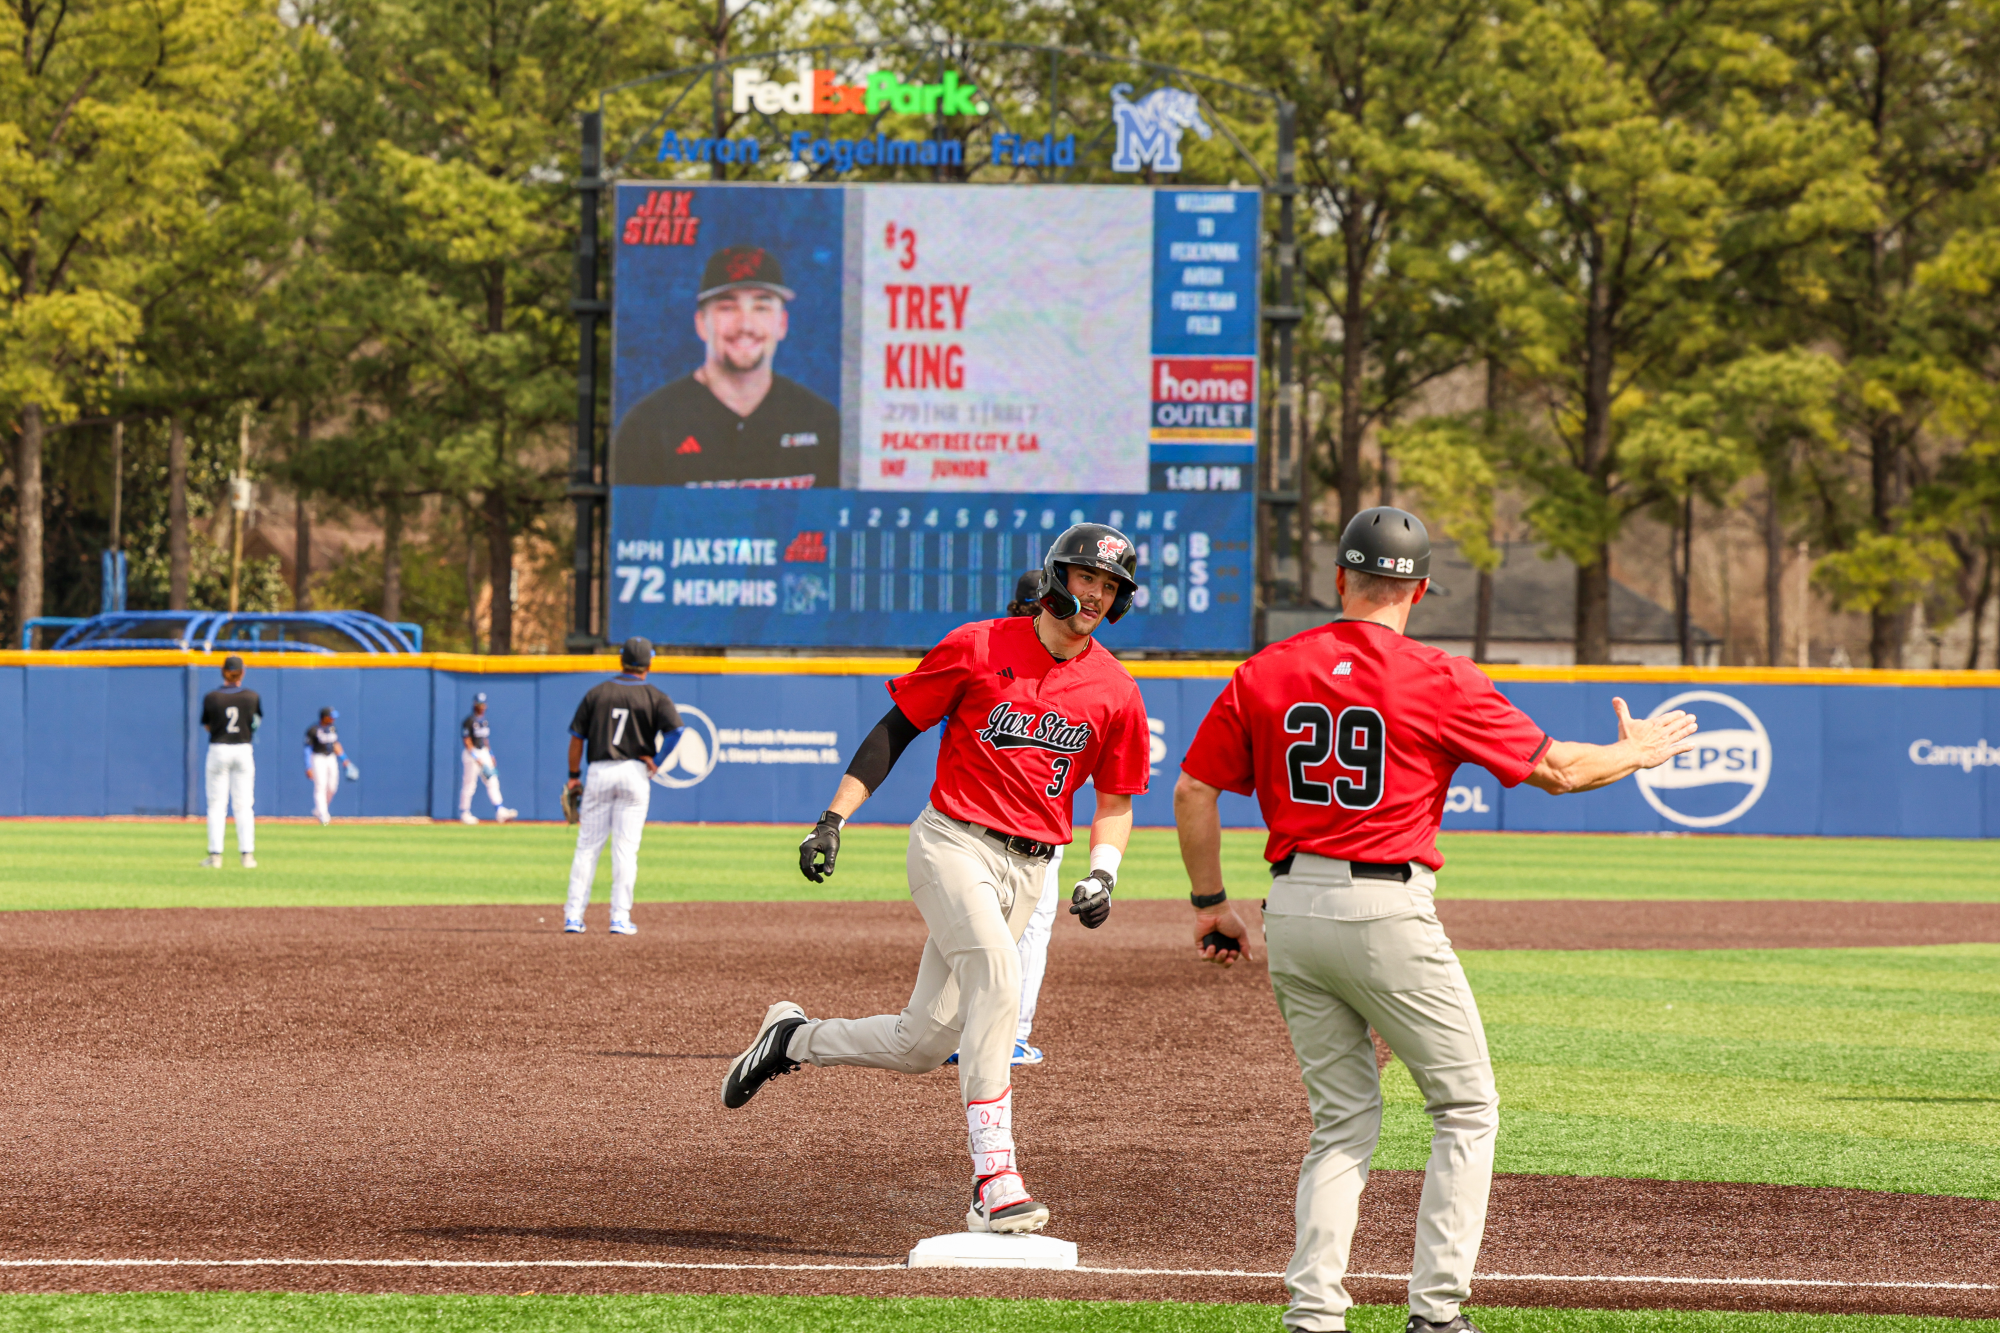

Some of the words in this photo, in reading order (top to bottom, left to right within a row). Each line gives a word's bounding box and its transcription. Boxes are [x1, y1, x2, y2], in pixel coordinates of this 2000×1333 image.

[658, 130, 759, 163] Avron
[790, 131, 961, 173] Fogelman
[991, 133, 1075, 167] Field
[636, 190, 695, 217] JAX
[623, 217, 699, 245] STATE
[884, 284, 970, 330] TREY
[884, 344, 965, 389] KING
[1160, 363, 1248, 402] home
[1157, 404, 1248, 427] OUTLET
[1209, 467, 1241, 490] PM
[839, 508, 849, 527] 1
[868, 508, 883, 528] 2
[897, 508, 911, 528] 3
[924, 508, 938, 528] 4
[956, 508, 969, 528] 5
[984, 509, 999, 529] 6
[1013, 509, 1028, 529] 7
[616, 540, 664, 561] MPH
[671, 538, 711, 568] JAX
[712, 538, 777, 565] STATE
[1162, 543, 1179, 566] 0
[1189, 532, 1210, 558] B
[1189, 560, 1209, 586] S
[1396, 558, 1415, 574] 29
[615, 566, 666, 603] 72
[672, 579, 777, 606] MEMPHIS
[1162, 584, 1179, 608] 0
[225, 706, 240, 733] 2
[612, 708, 630, 746] 7
[979, 702, 1036, 742] Jax
[1034, 711, 1092, 748] State
[1284, 702, 1386, 810] 29
[1673, 746, 1759, 771] EPSI
[1045, 757, 1071, 798] 3
